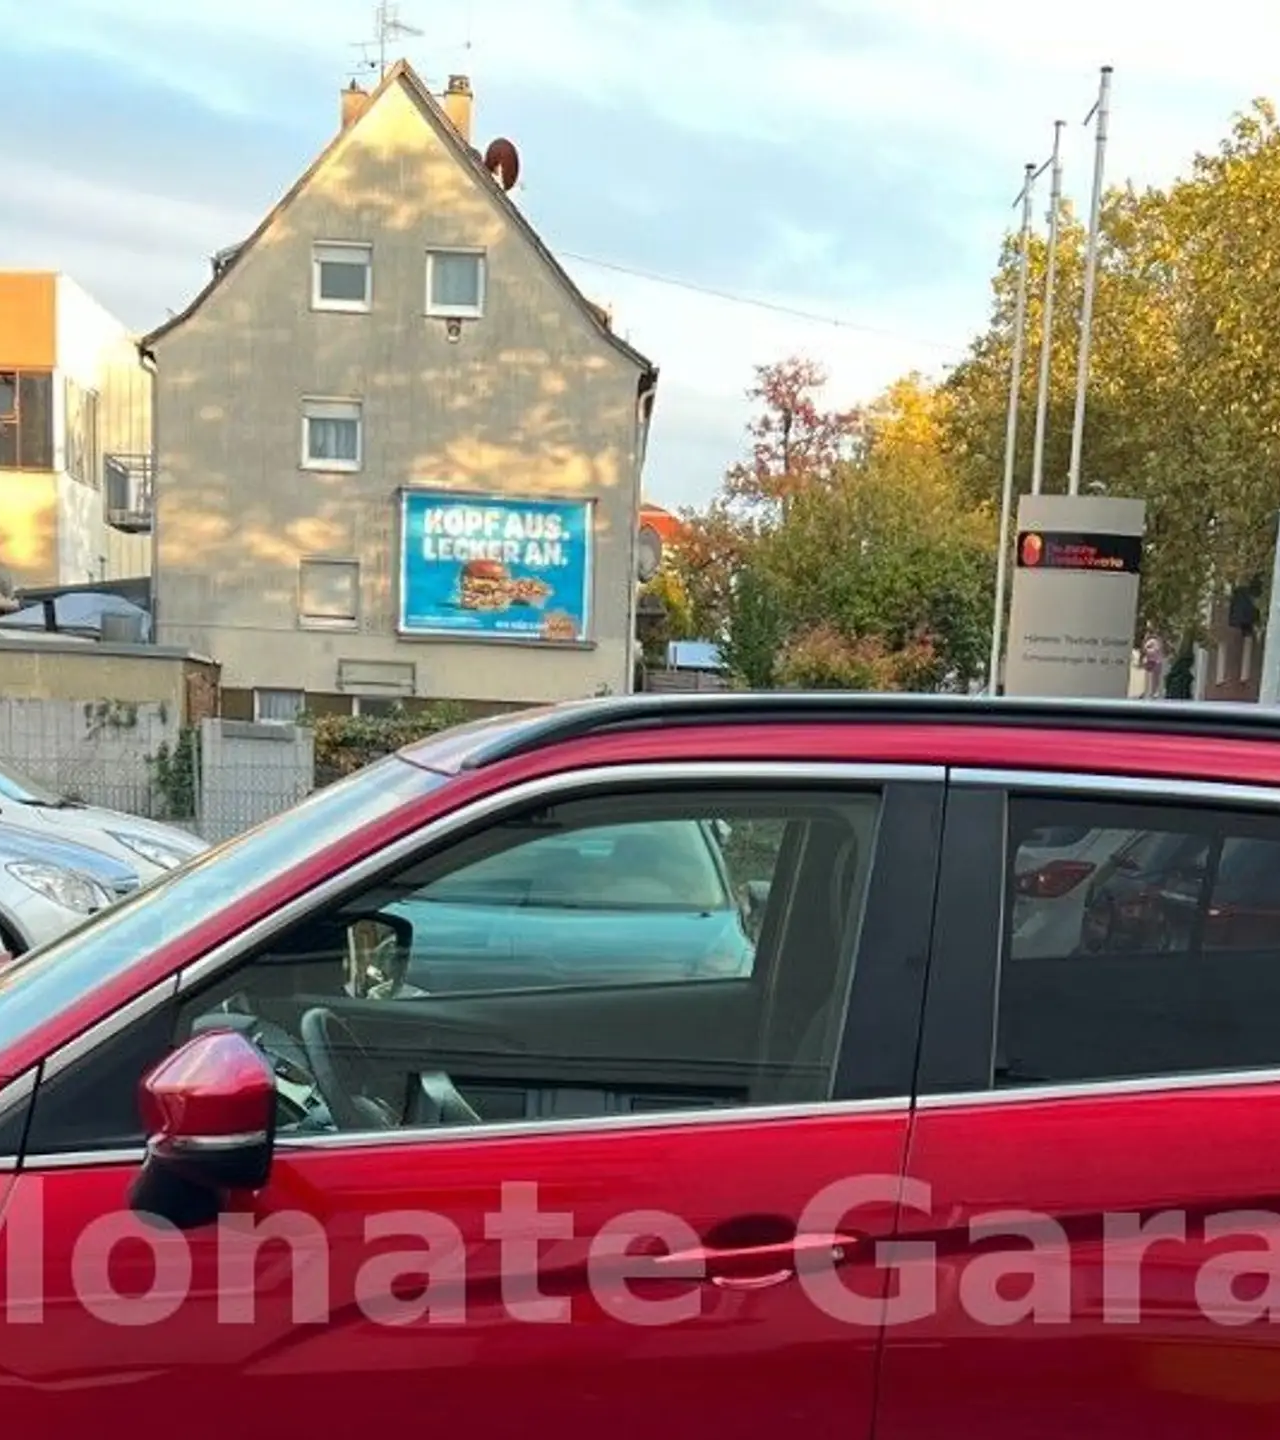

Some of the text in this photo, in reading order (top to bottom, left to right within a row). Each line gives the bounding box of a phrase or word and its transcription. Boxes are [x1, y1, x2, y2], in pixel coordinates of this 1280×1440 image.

[423, 507, 571, 541] KOPF AUS.
[422, 537, 569, 566] LECKER AN.
